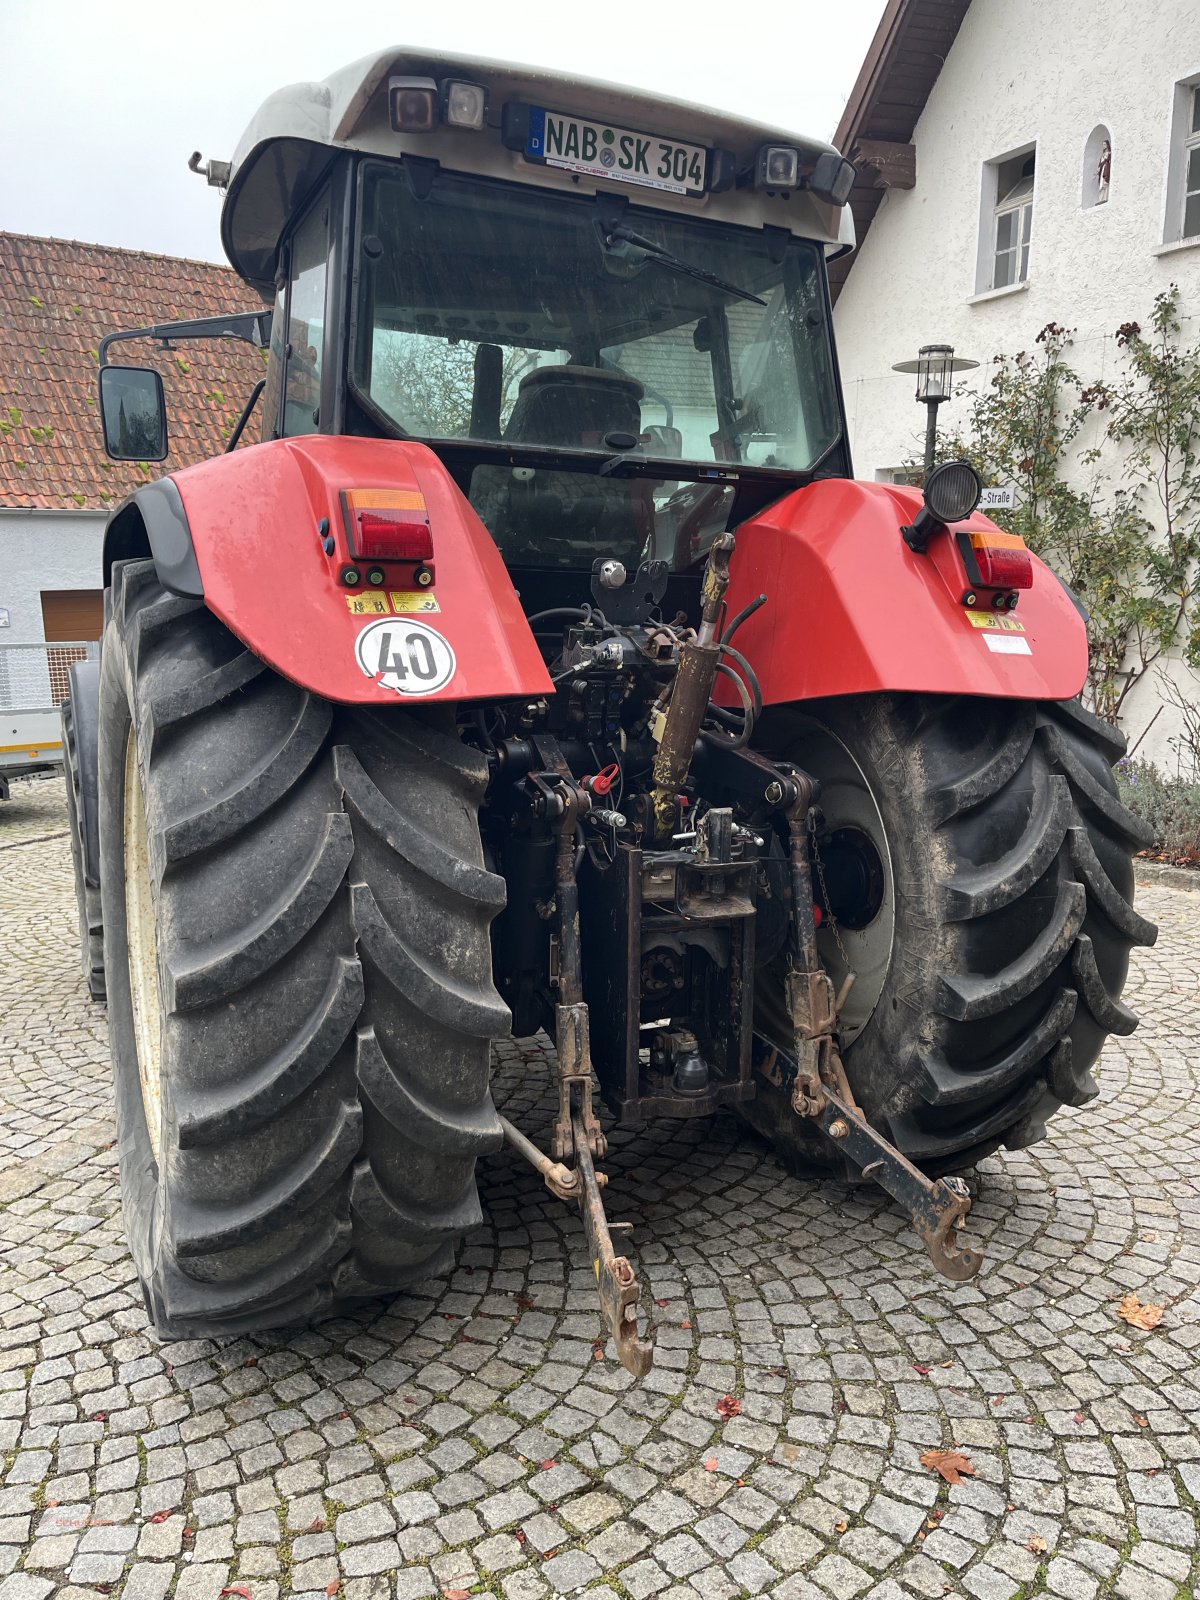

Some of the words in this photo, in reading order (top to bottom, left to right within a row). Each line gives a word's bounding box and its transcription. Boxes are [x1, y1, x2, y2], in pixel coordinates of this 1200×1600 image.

[532, 138, 539, 148] D
[546, 118, 598, 162] NAB
[618, 135, 651, 174] SK
[657, 143, 701, 186] 304
[378, 632, 438, 681] 40
